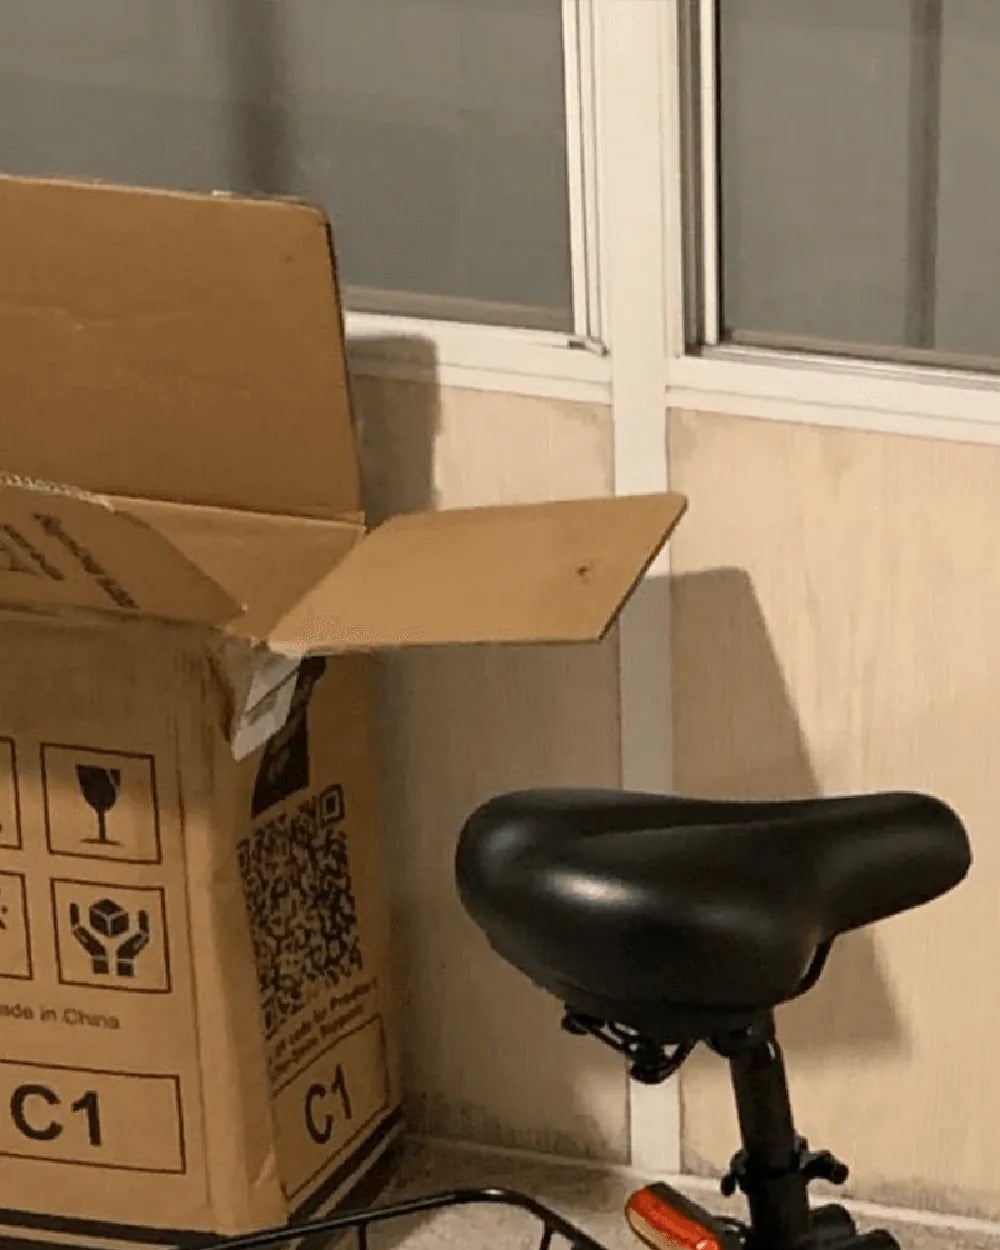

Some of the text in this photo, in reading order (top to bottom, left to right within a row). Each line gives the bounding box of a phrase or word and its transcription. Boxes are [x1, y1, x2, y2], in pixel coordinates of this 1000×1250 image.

[0, 1003, 120, 1030] ade in China
[10, 1084, 102, 1146] C1
[305, 1064, 352, 1144] C1
